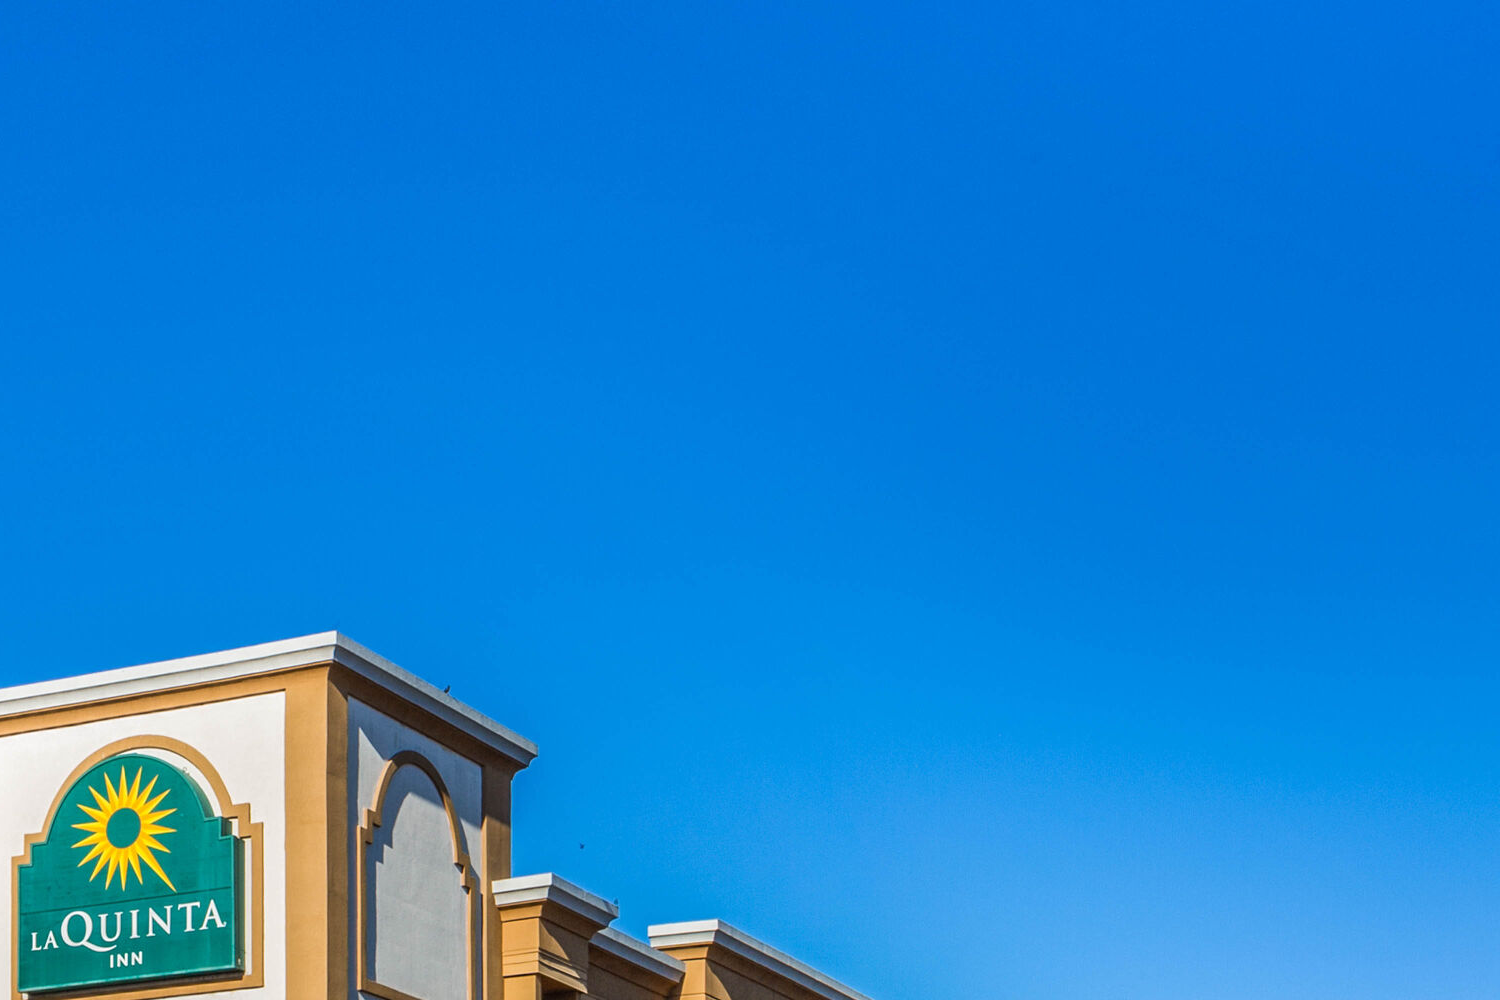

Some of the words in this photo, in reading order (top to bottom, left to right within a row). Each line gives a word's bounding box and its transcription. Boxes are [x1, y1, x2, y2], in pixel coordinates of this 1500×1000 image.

[31, 930, 59, 951] LA
[61, 899, 227, 952] QUINTA
[110, 951, 143, 968] INN
